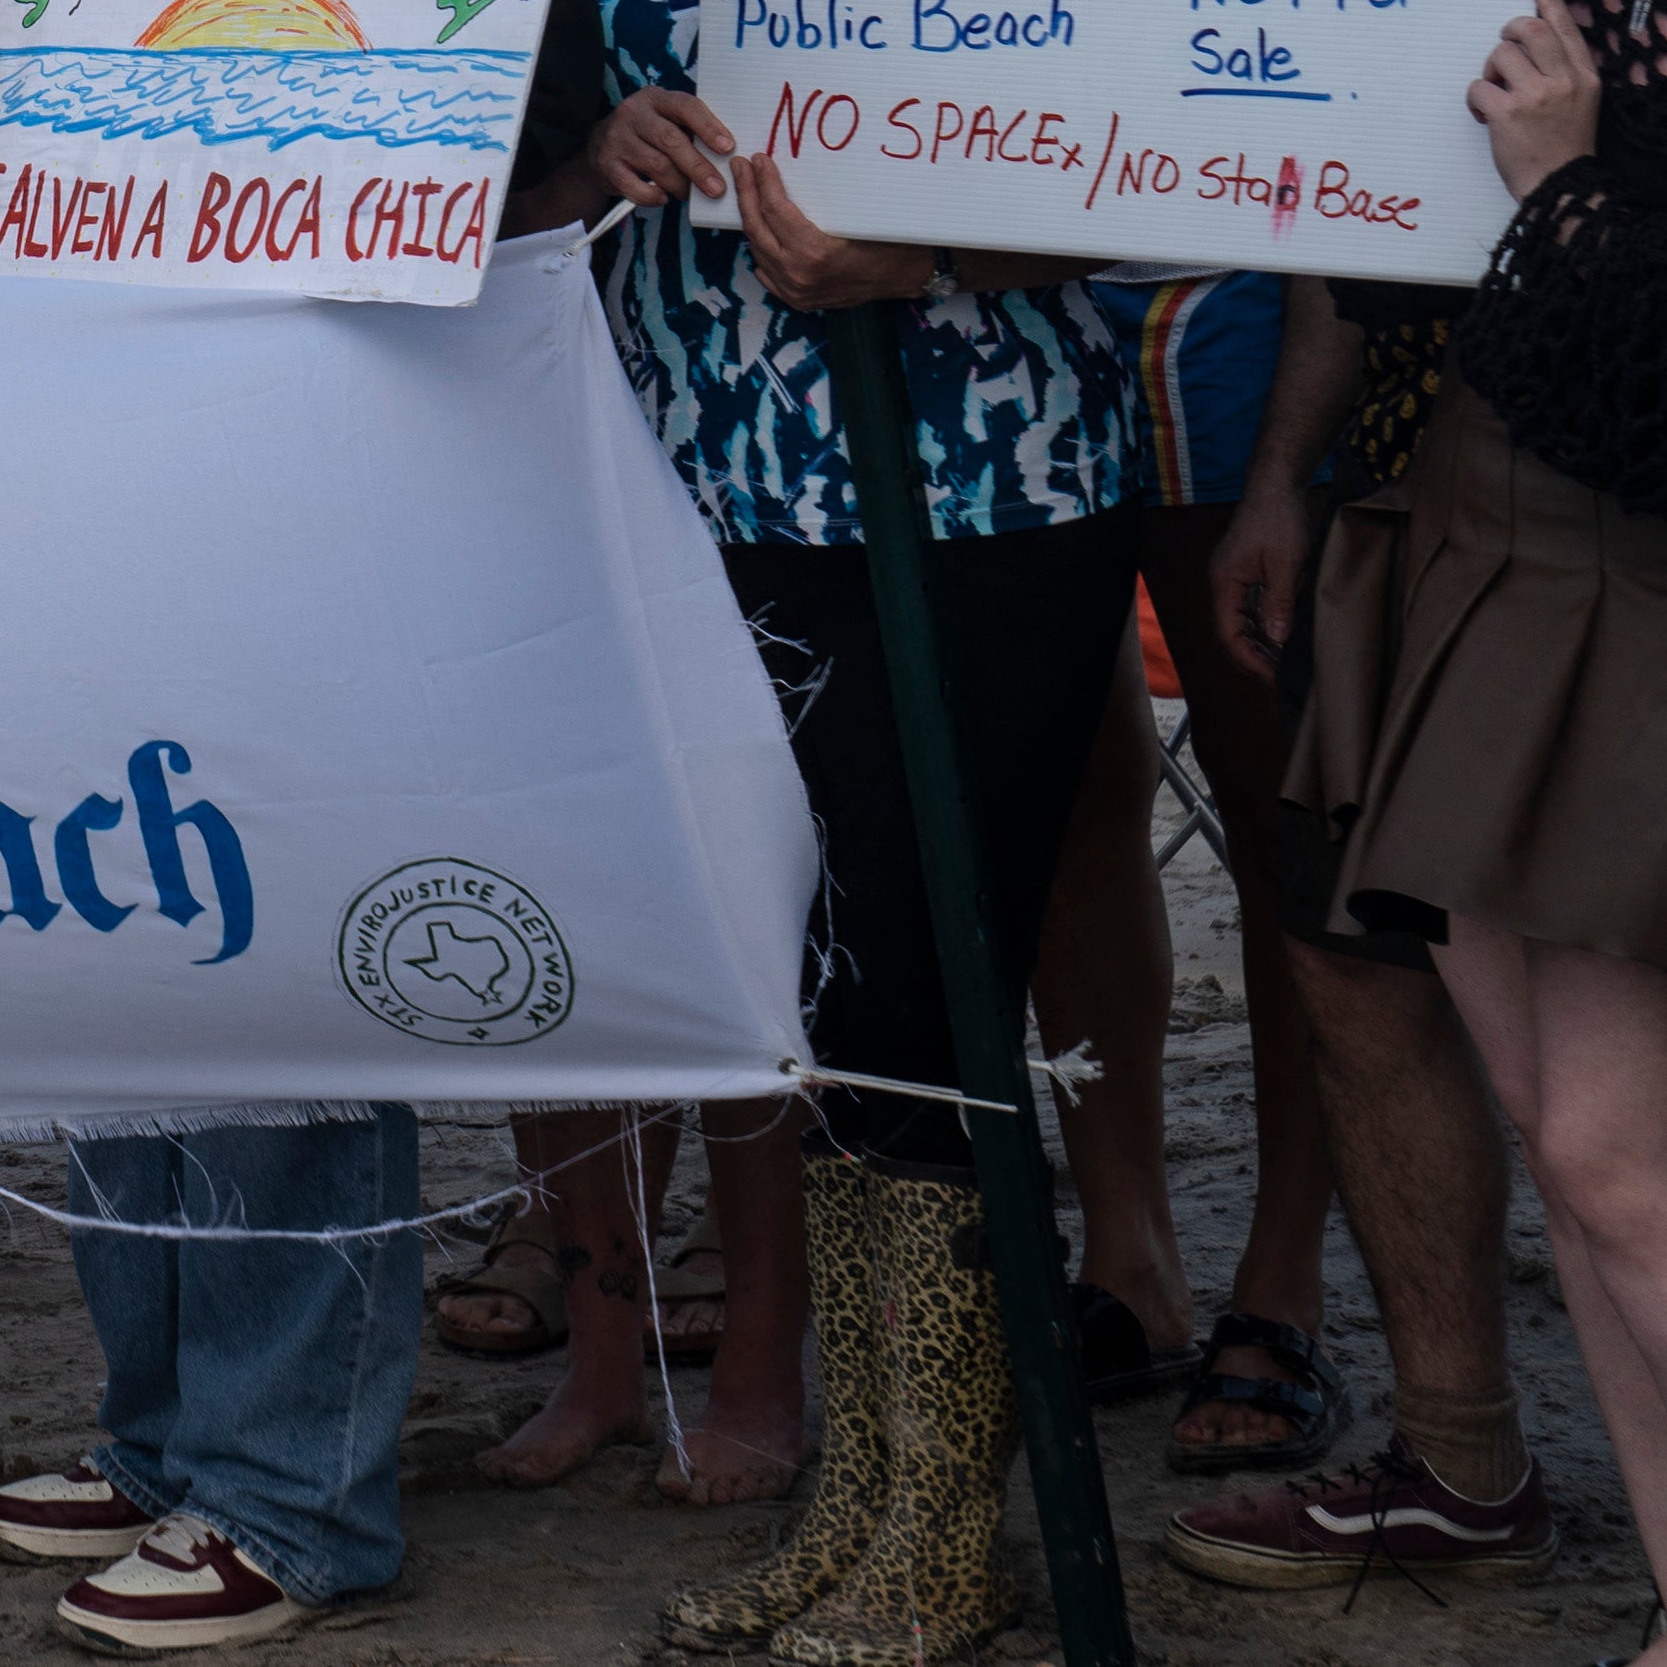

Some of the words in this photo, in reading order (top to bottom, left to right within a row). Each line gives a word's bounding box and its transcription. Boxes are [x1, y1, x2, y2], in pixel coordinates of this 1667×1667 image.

[768, 81, 860, 159] NO
[1314, 160, 1421, 231] Base
[131, 178, 168, 259] A
[187, 172, 324, 263] BOCA
[344, 175, 491, 269] CHICA
[353, 874, 496, 987] ENVIROJUSTICE
[503, 897, 565, 1030] NETWORK
[373, 992, 424, 1027] STX
